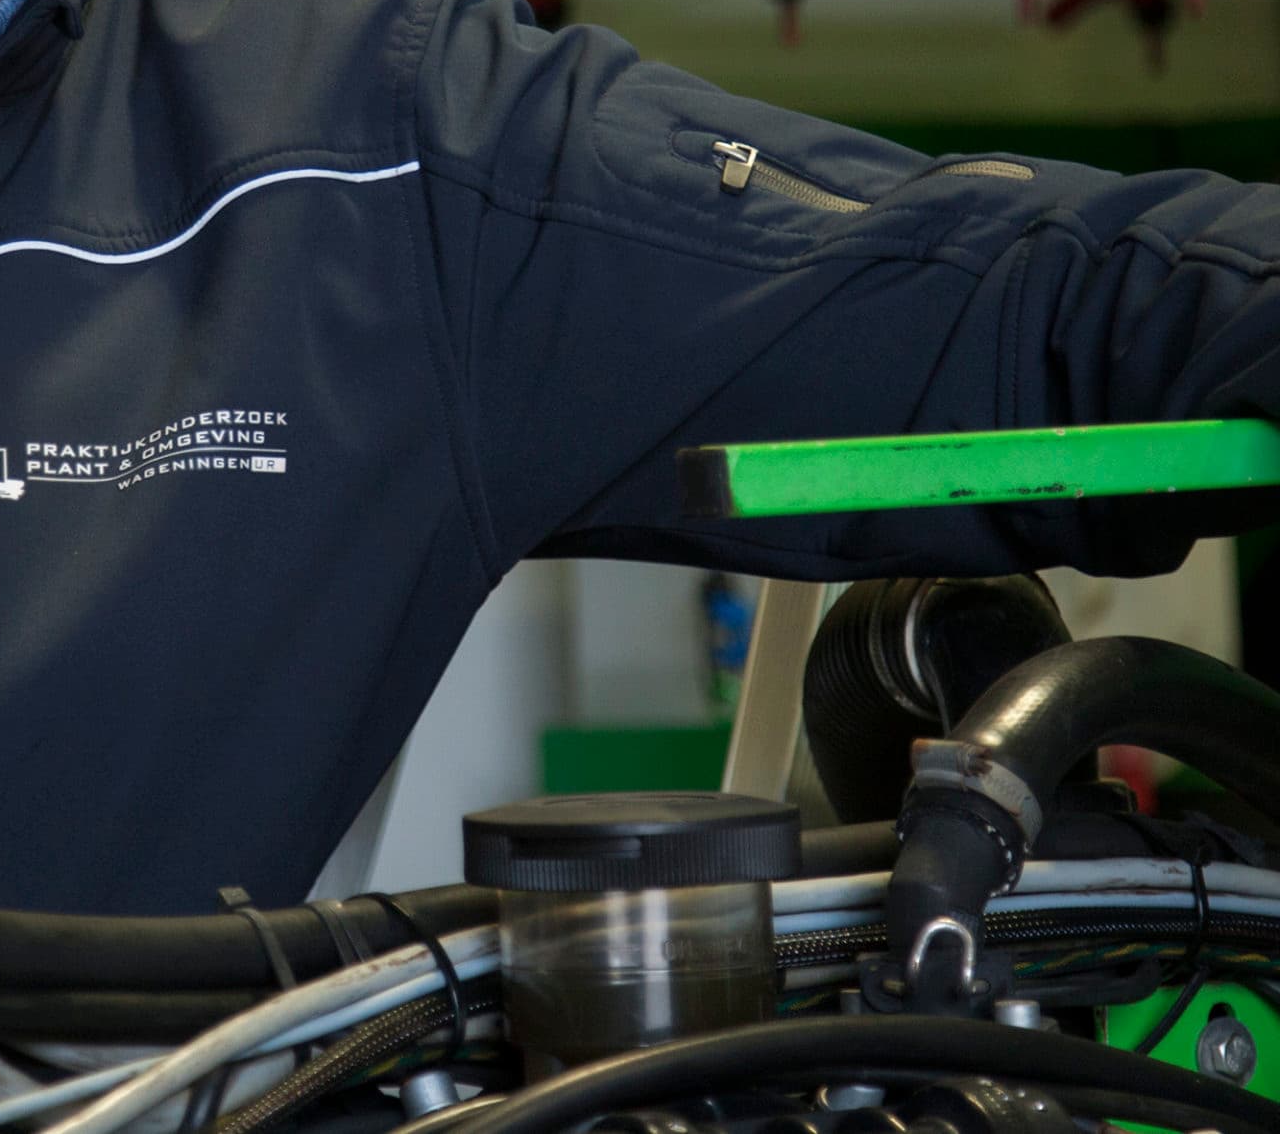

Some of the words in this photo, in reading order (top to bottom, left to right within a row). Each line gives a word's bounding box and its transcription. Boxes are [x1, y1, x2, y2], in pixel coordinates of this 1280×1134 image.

[25, 409, 288, 459] PRAKTIJKONDERZOEK
[25, 460, 109, 476] PLANT
[118, 458, 132, 471] &
[142, 429, 265, 461] OMGEVING
